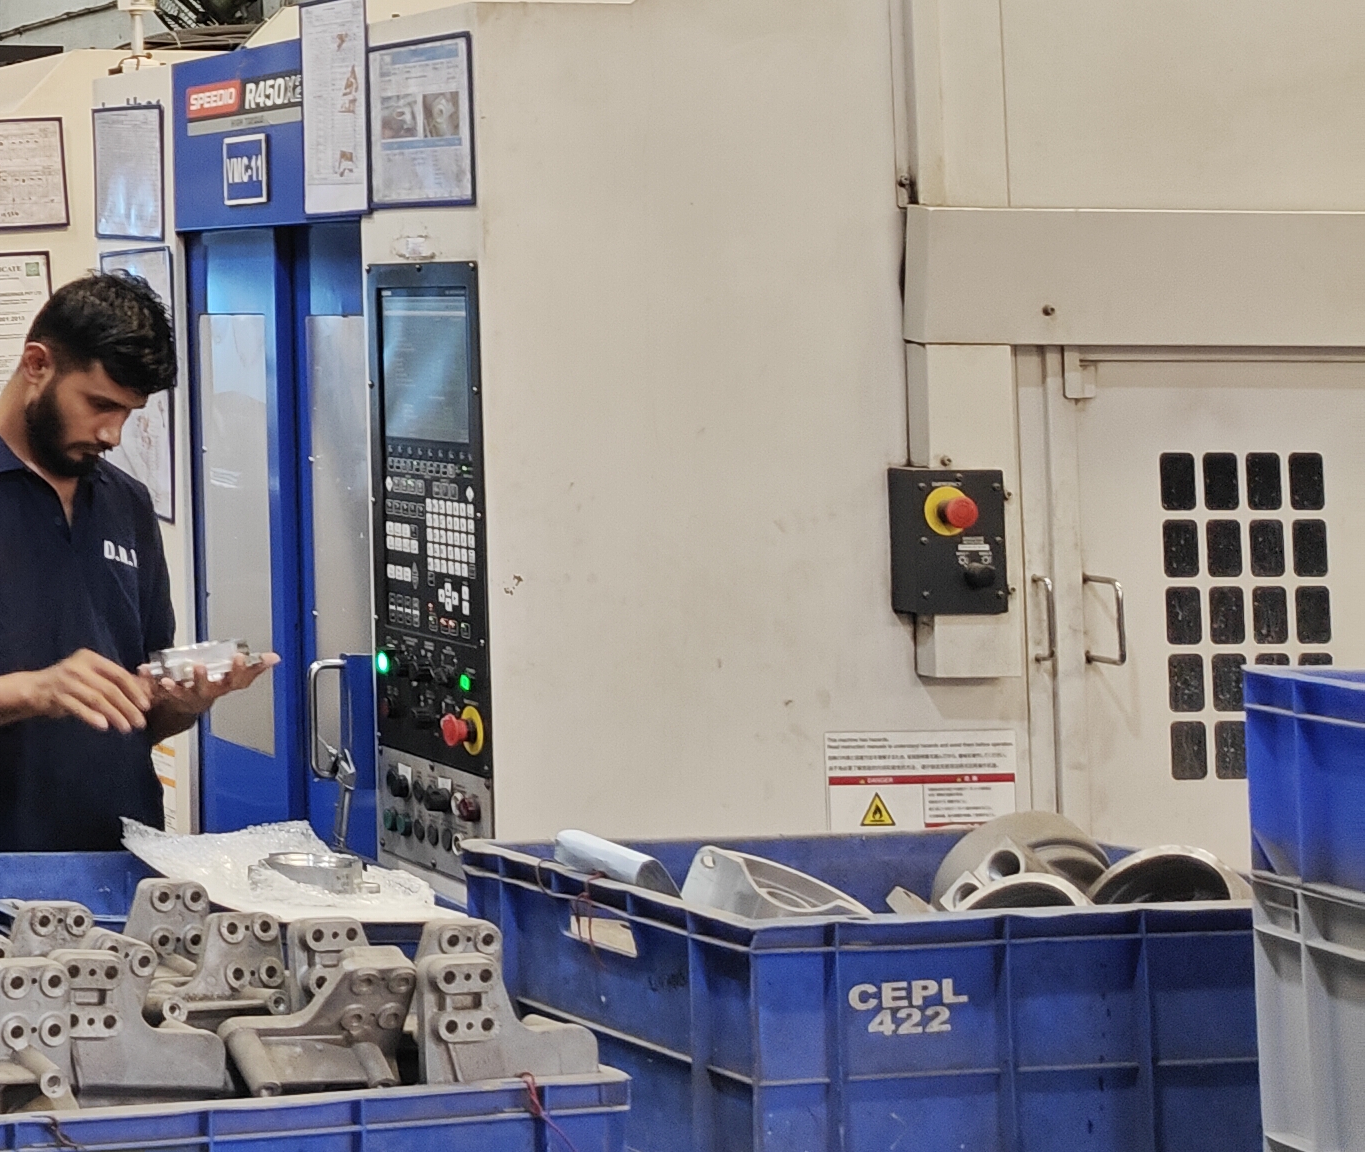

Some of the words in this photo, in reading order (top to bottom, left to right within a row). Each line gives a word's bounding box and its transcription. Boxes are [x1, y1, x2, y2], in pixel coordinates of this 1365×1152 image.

[189, 88, 236, 110] SPEEDIO
[227, 154, 263, 184] VMC-11
[848, 978, 969, 1010] CEPL
[867, 1006, 951, 1036] 422
